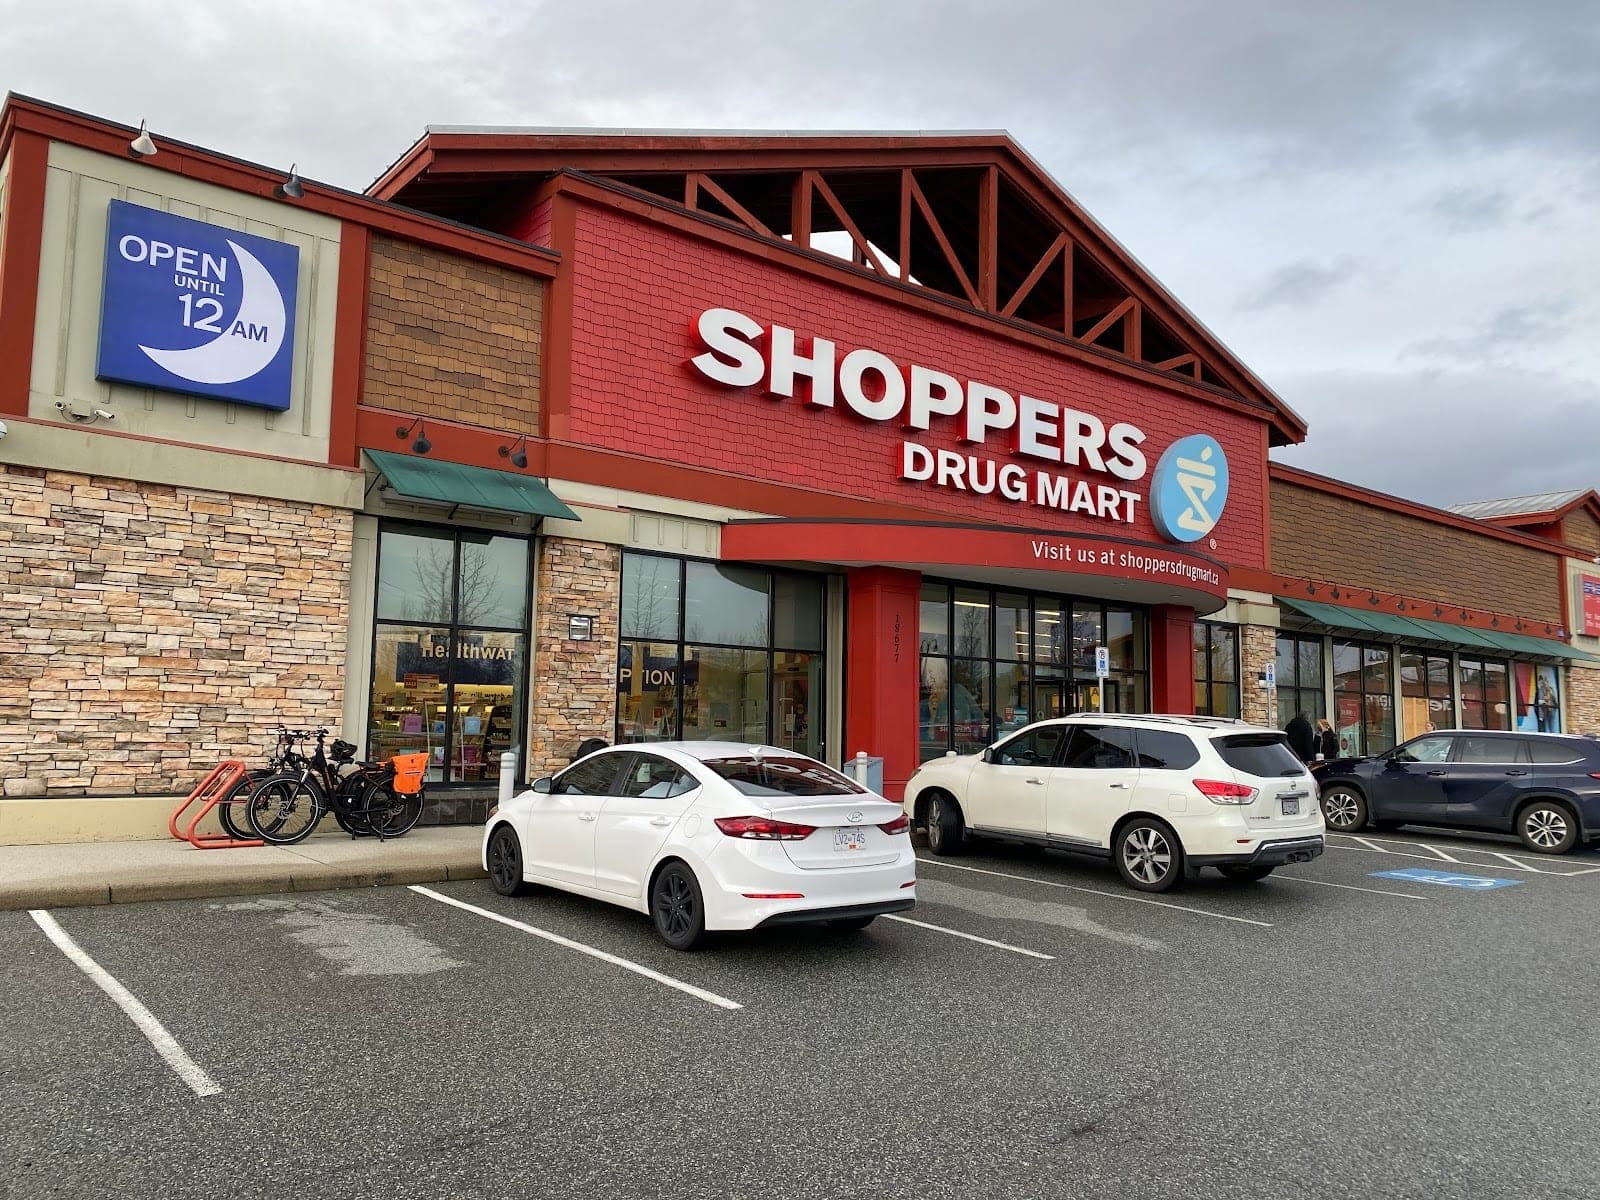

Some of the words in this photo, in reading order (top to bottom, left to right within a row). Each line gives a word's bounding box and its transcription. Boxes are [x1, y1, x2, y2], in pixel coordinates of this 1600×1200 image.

[119, 234, 227, 282] OPEN
[174, 273, 225, 297] UNTIL
[178, 293, 224, 334] 12
[231, 320, 268, 343] AM
[691, 307, 1147, 481] SHOPPERS
[901, 440, 1028, 502] DRUG
[1036, 472, 1142, 524] MART
[1031, 540, 1072, 562] Visit
[1077, 549, 1096, 564] us
[1100, 549, 1116, 566] at
[1119, 551, 1219, 585] shoppersdrugmart.ca
[421, 640, 516, 661] HelthWAT
